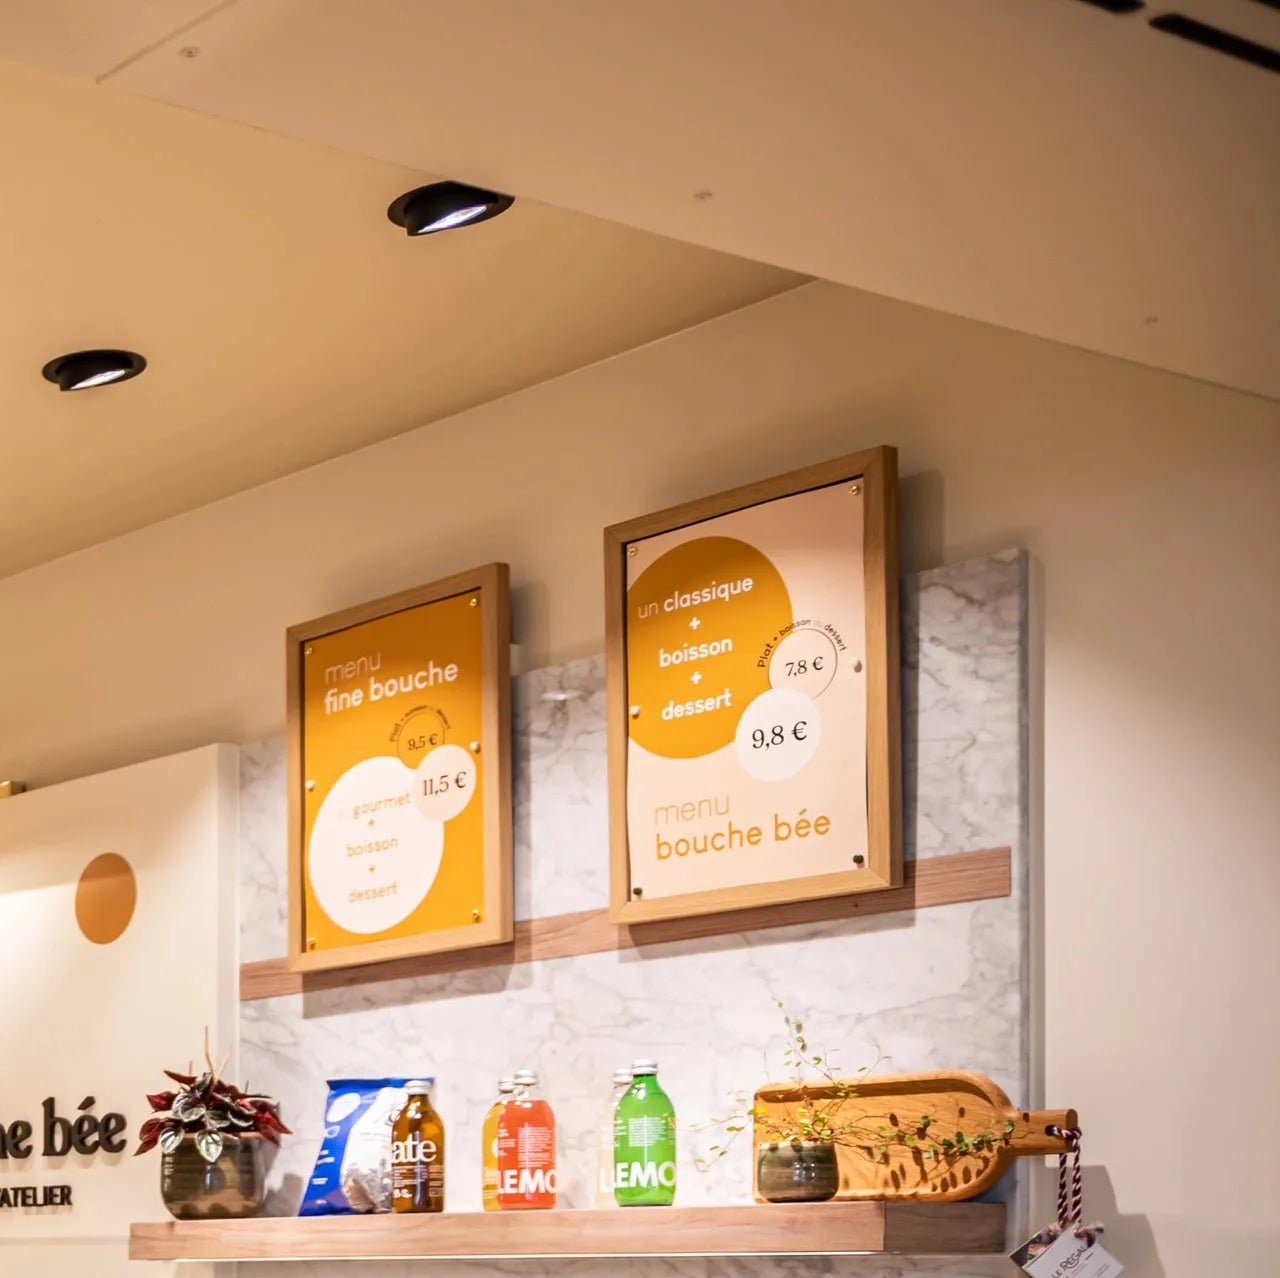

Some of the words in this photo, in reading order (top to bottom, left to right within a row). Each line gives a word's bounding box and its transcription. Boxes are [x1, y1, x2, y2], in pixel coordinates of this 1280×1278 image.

[638, 600, 658, 619] un
[663, 577, 753, 613] classique
[659, 637, 733, 668] boisson
[756, 642, 774, 668] Plat
[779, 619, 811, 636] boisson
[823, 623, 847, 652] dessert
[325, 653, 381, 684] menu
[784, 659, 807, 678] 7,8
[813, 656, 824, 671] €
[325, 687, 363, 715] fine
[369, 661, 459, 701] bouche
[661, 688, 733, 721] dessert
[408, 738, 426, 751] 9,5
[429, 733, 438, 745] €
[752, 726, 785, 750] 9,8
[792, 720, 807, 741] €
[422, 775, 450, 797] 11,5
[455, 771, 467, 789] €
[353, 792, 411, 819] gourmet
[655, 796, 730, 826] menu
[346, 836, 399, 858] boisson
[656, 821, 762, 861] bouche
[774, 808, 831, 841] bée
[348, 881, 398, 903] dessert
[41, 1096, 128, 1157] bée
